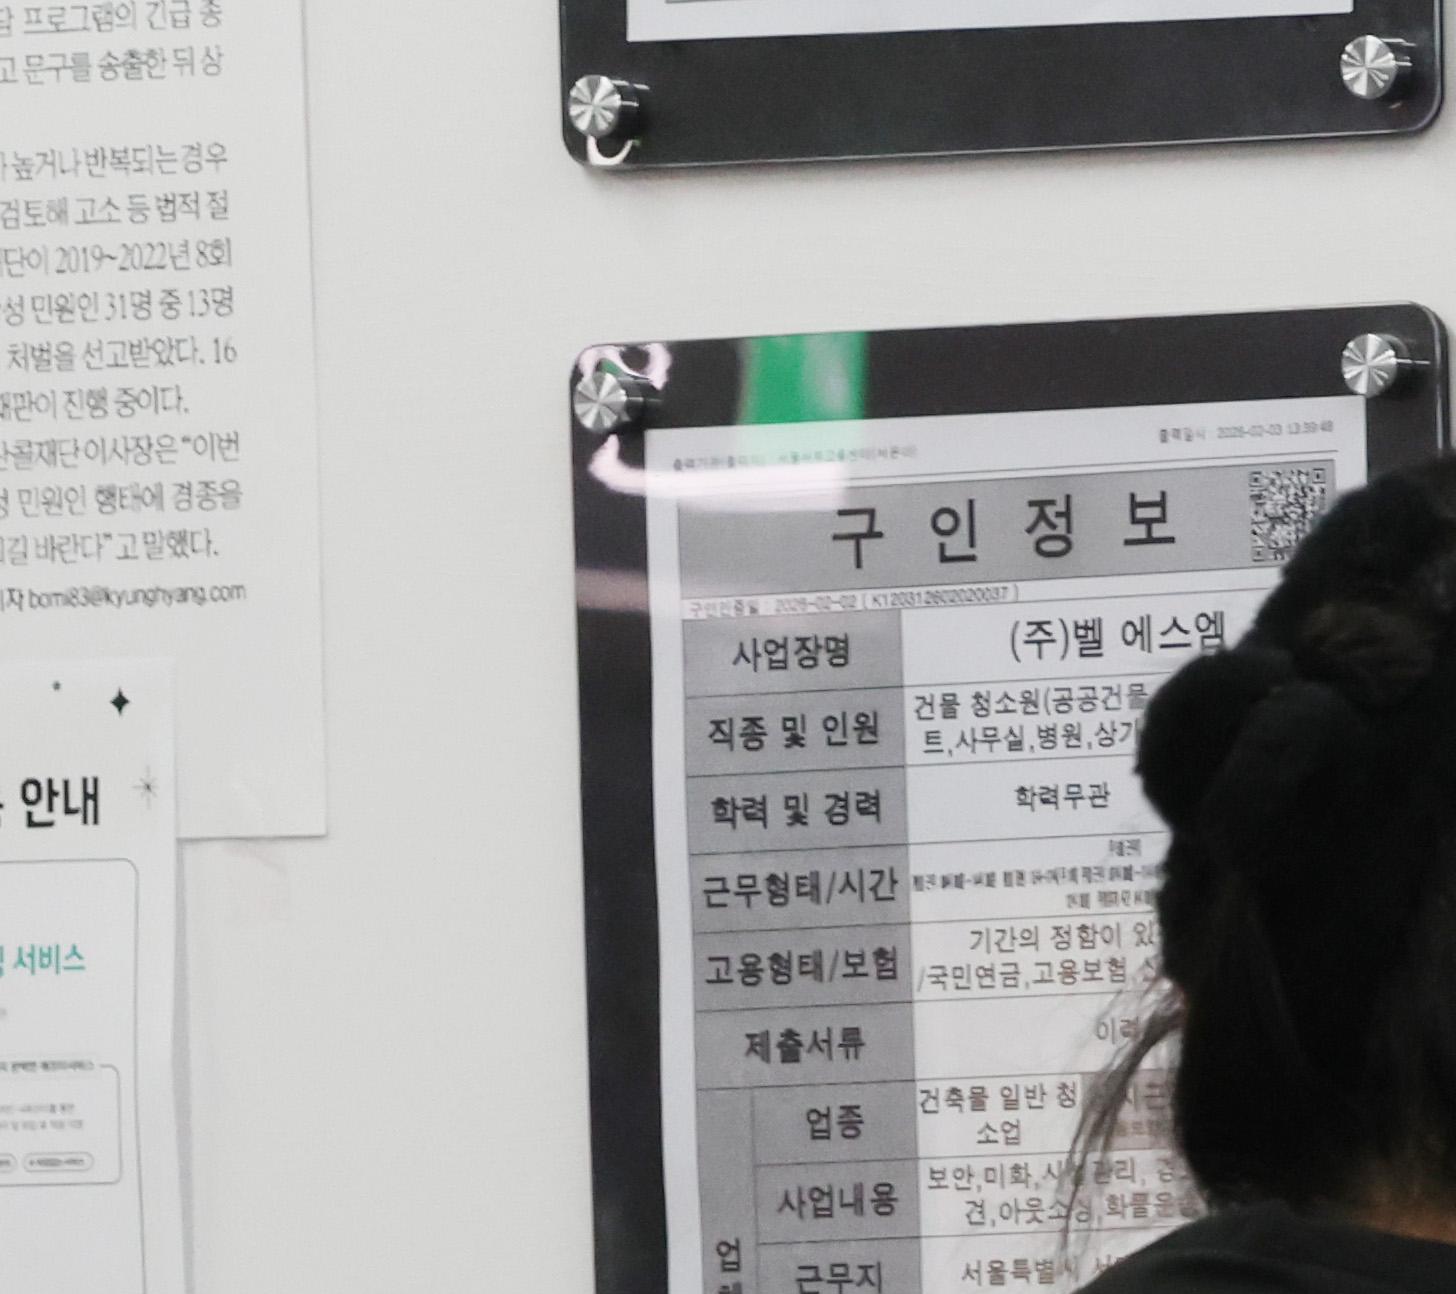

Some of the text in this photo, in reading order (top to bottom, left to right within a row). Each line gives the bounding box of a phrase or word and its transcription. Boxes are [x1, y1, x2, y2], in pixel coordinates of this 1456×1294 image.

[24, 1, 137, 34] 프로그램의
[732, 633, 850, 673] 사업장명
[1010, 617, 1104, 663] (주)벨
[707, 710, 879, 752] 직종 및 인원
[21, 776, 99, 828] 안내
[702, 866, 899, 909] 근무형태/시간
[13, 944, 86, 975] 서비스
[744, 1026, 866, 1065] 제출서류
[919, 1083, 1048, 1115] 건축물 일반
